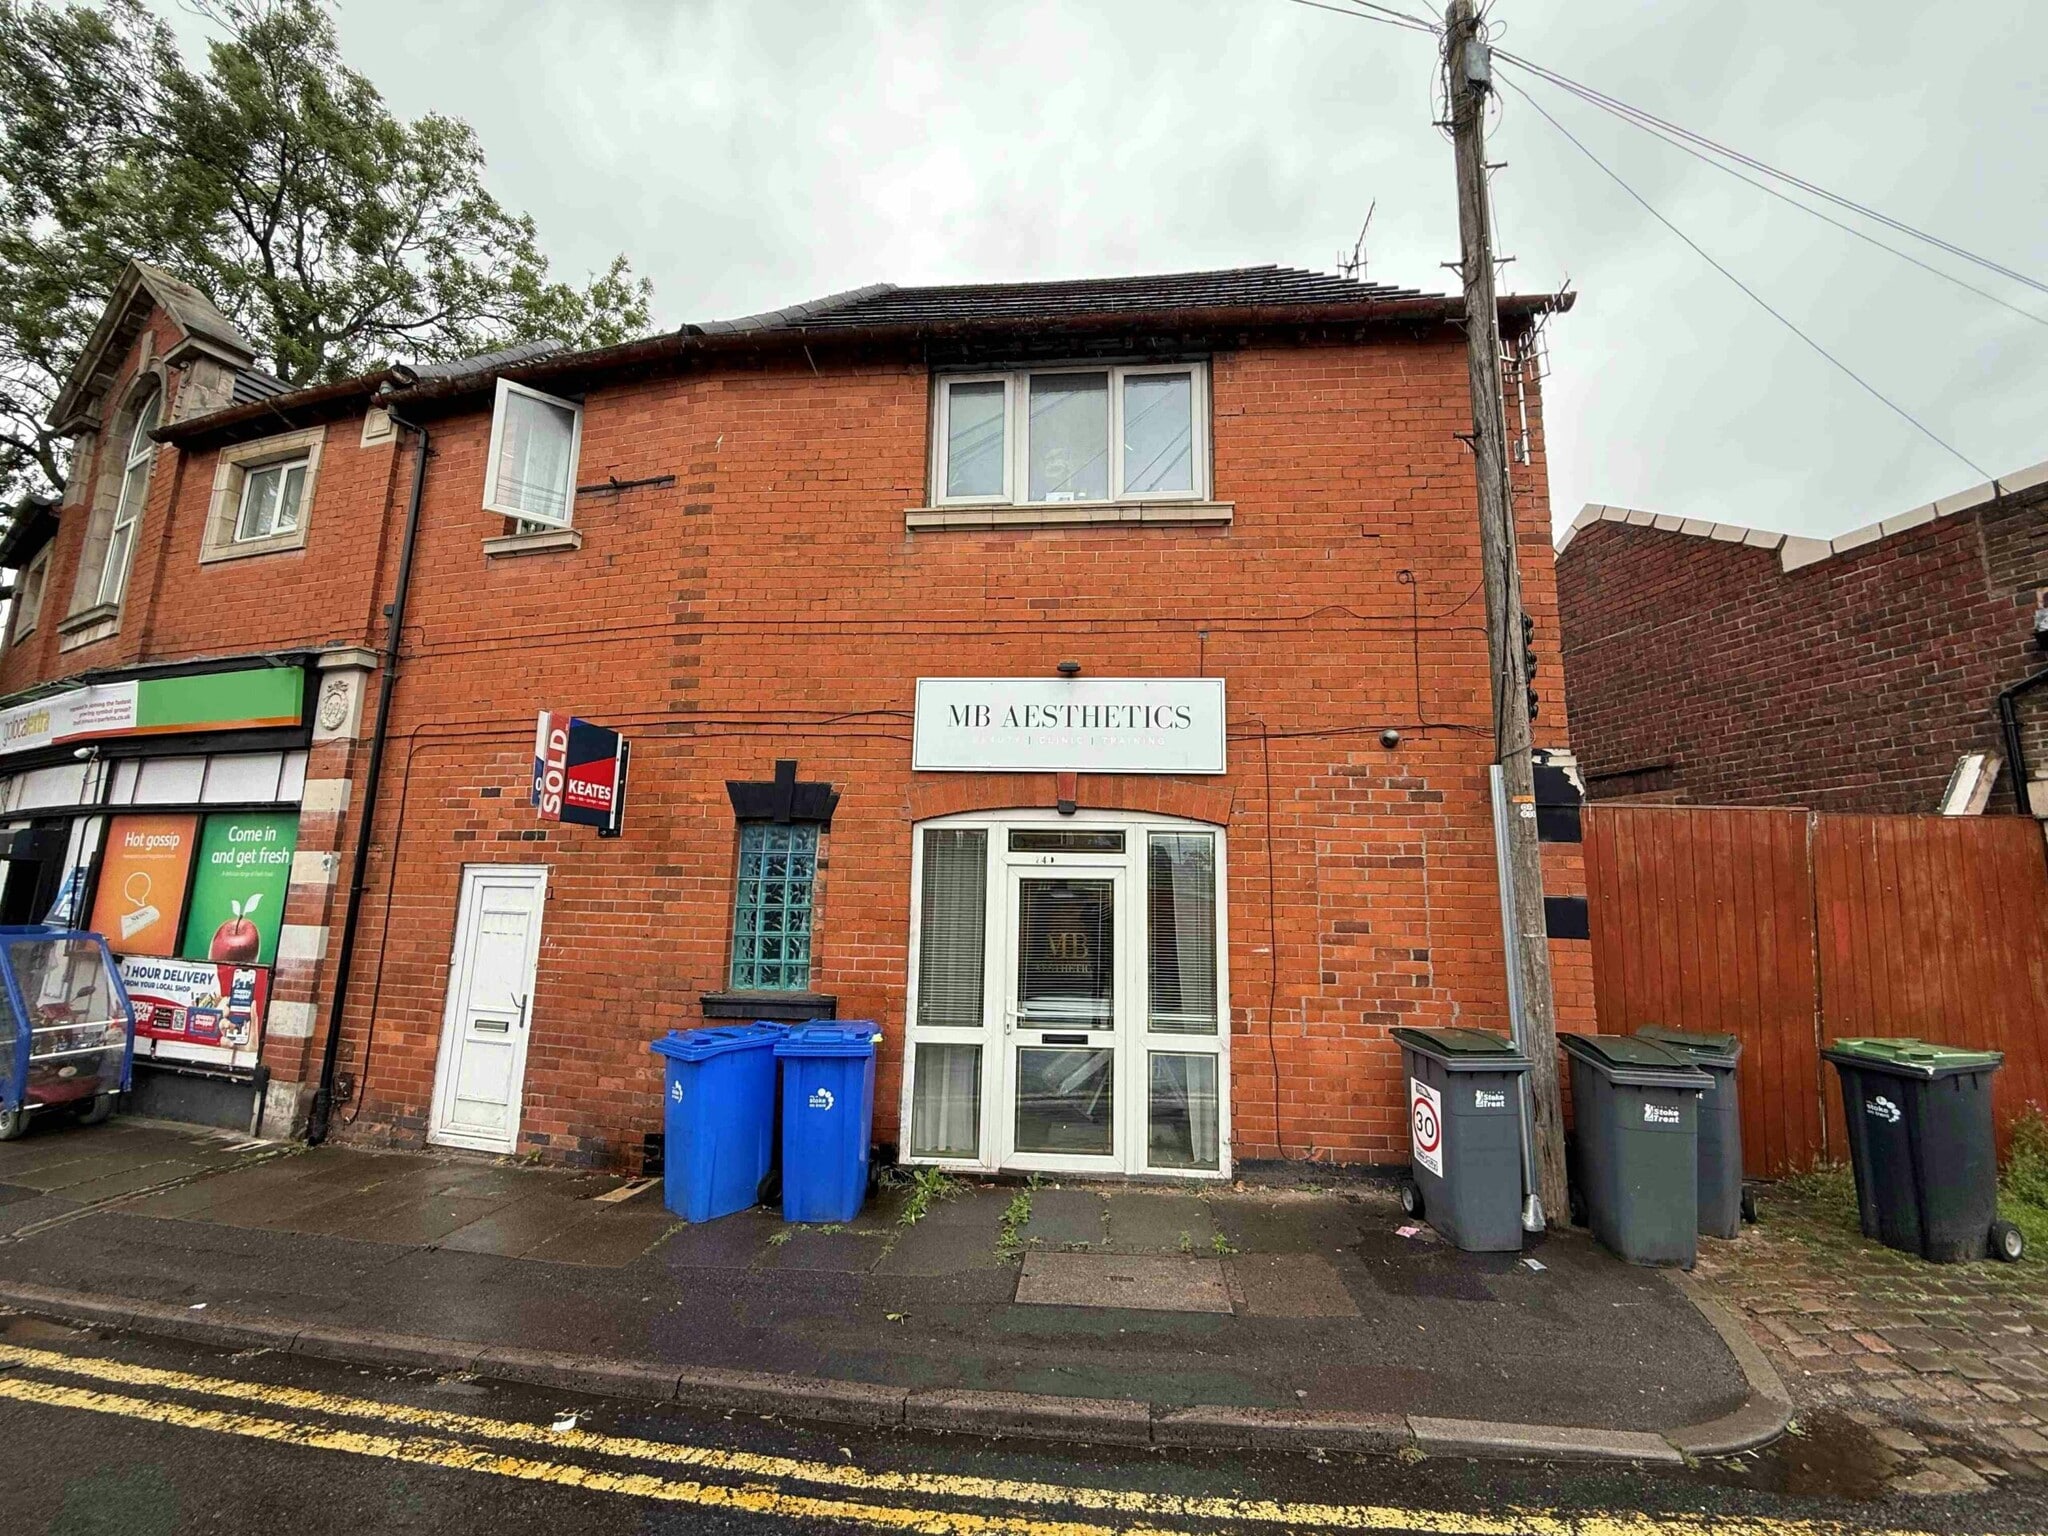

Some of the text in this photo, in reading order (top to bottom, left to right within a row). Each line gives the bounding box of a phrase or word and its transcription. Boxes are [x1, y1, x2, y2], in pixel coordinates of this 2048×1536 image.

[947, 704, 1192, 729] MB AESTHETICS
[1038, 736, 1083, 745] CLINIC
[1102, 736, 1166, 745] TRAINING
[542, 729, 567, 814] SOLD
[569, 779, 611, 800] KEATES
[125, 832, 180, 850] Hot gossip
[228, 826, 276, 842] Come in
[211, 847, 290, 868] and get fresh
[125, 965, 215, 985] 1 HOUR DELIVERY
[140, 981, 155, 989] YOUR
[156, 982, 174, 991] LOCAL
[175, 985, 191, 993] SHOP
[1653, 1108, 1680, 1117] Stoke
[1653, 1115, 1680, 1123] Trent
[1416, 1110, 1434, 1138] 30
